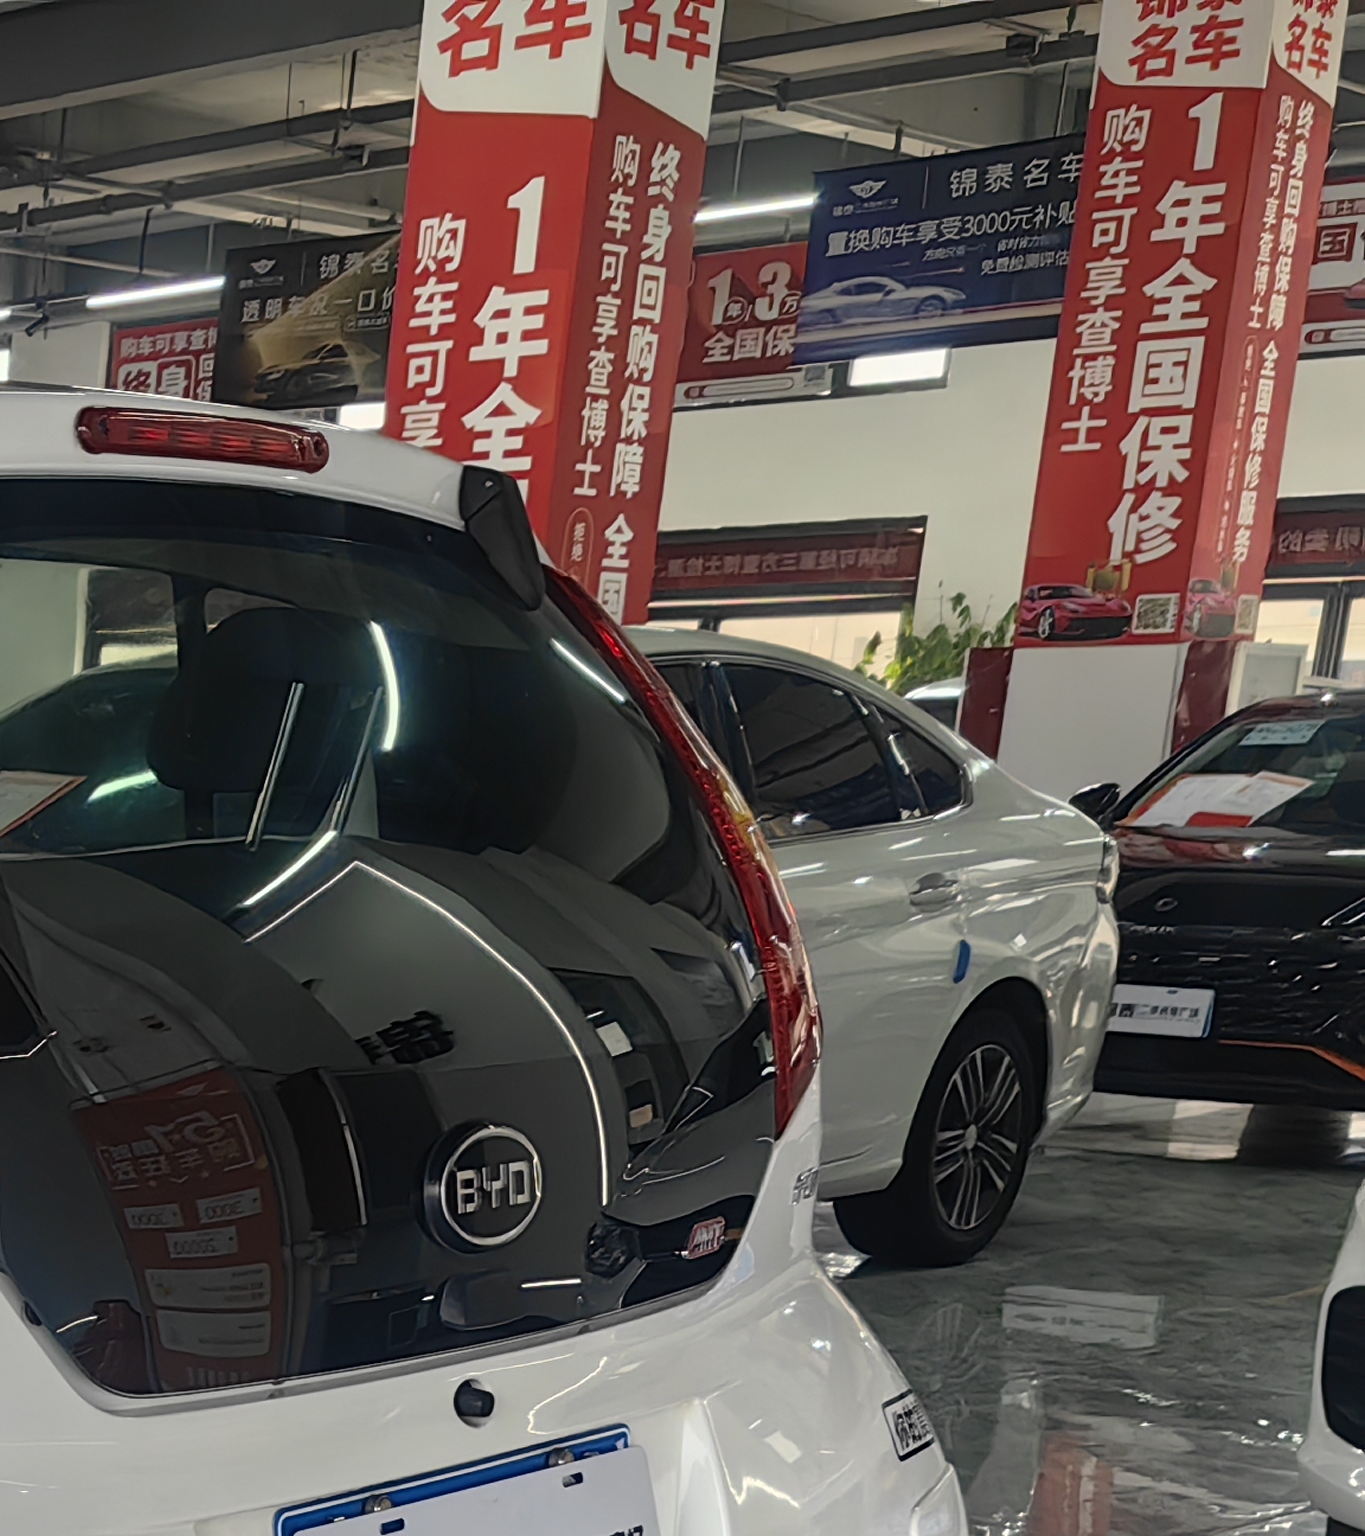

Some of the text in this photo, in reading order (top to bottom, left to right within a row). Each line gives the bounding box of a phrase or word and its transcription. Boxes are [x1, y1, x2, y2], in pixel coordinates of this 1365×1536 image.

[436, 0, 593, 78] 名车
[618, 0, 715, 70] 名车
[1127, 15, 1244, 82] 名车
[1284, 14, 1333, 80] 名车
[318, 249, 400, 280] 锦泰名
[949, 153, 1084, 199] 锦泰名车
[1060, 103, 1151, 453] 购车可享查博士
[1248, 95, 1294, 329] 购车可享查博士
[1266, 99, 1315, 331] 终身回购保障
[400, 212, 466, 449] 购车可享
[460, 174, 551, 490] 1年全
[573, 134, 642, 499] 购车可享查博士
[610, 141, 683, 501] 终身回购保障
[702, 323, 798, 366] 全国保
[1107, 91, 1227, 567] 1年全国保修
[1232, 340, 1279, 564] 全国保修服务
[456, 1160, 532, 1214] BYD
